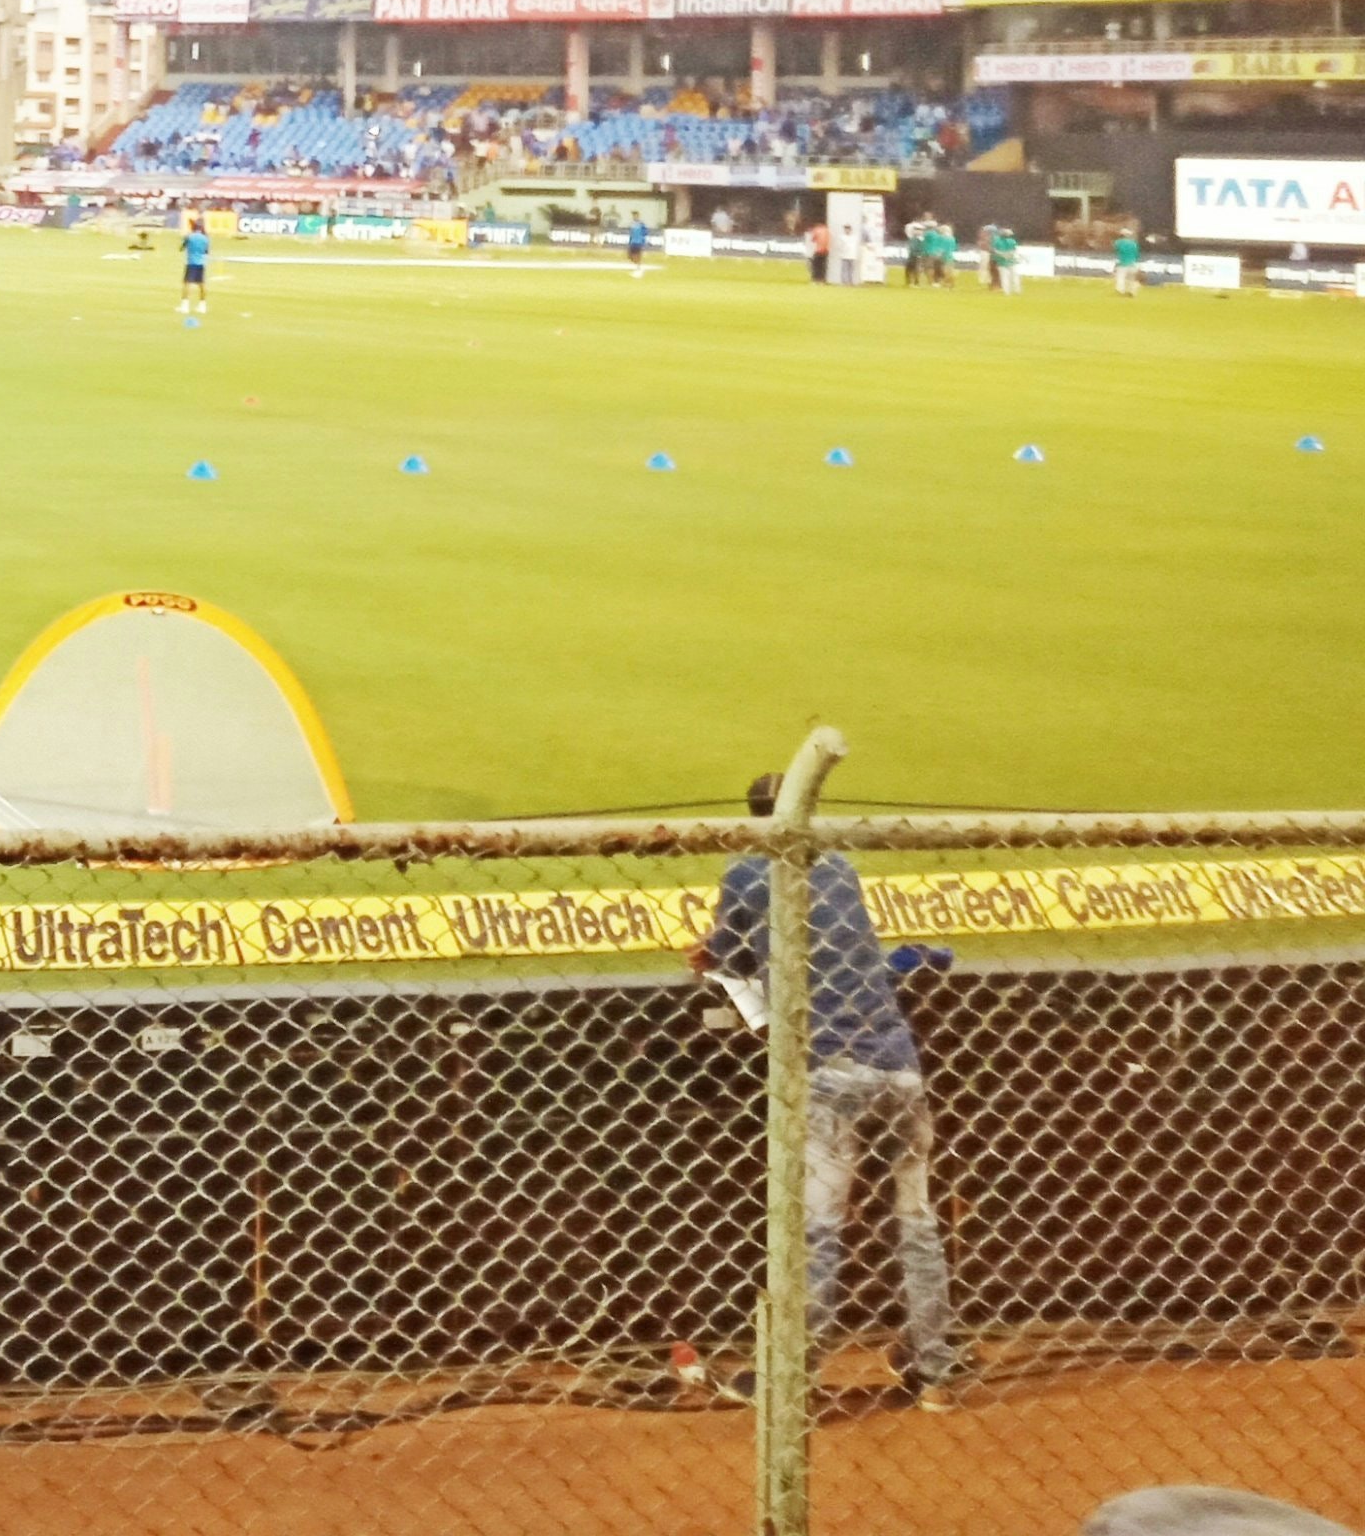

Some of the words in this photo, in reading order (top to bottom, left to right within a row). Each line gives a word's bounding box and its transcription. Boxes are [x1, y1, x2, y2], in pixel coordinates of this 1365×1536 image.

[1187, 176, 1310, 209] TATA
[238, 218, 298, 235] COMFY
[1057, 872, 1201, 924] Cement
[13, 907, 230, 965] UltraTech
[260, 905, 430, 957] Cement
[451, 891, 654, 954] UltraTech
